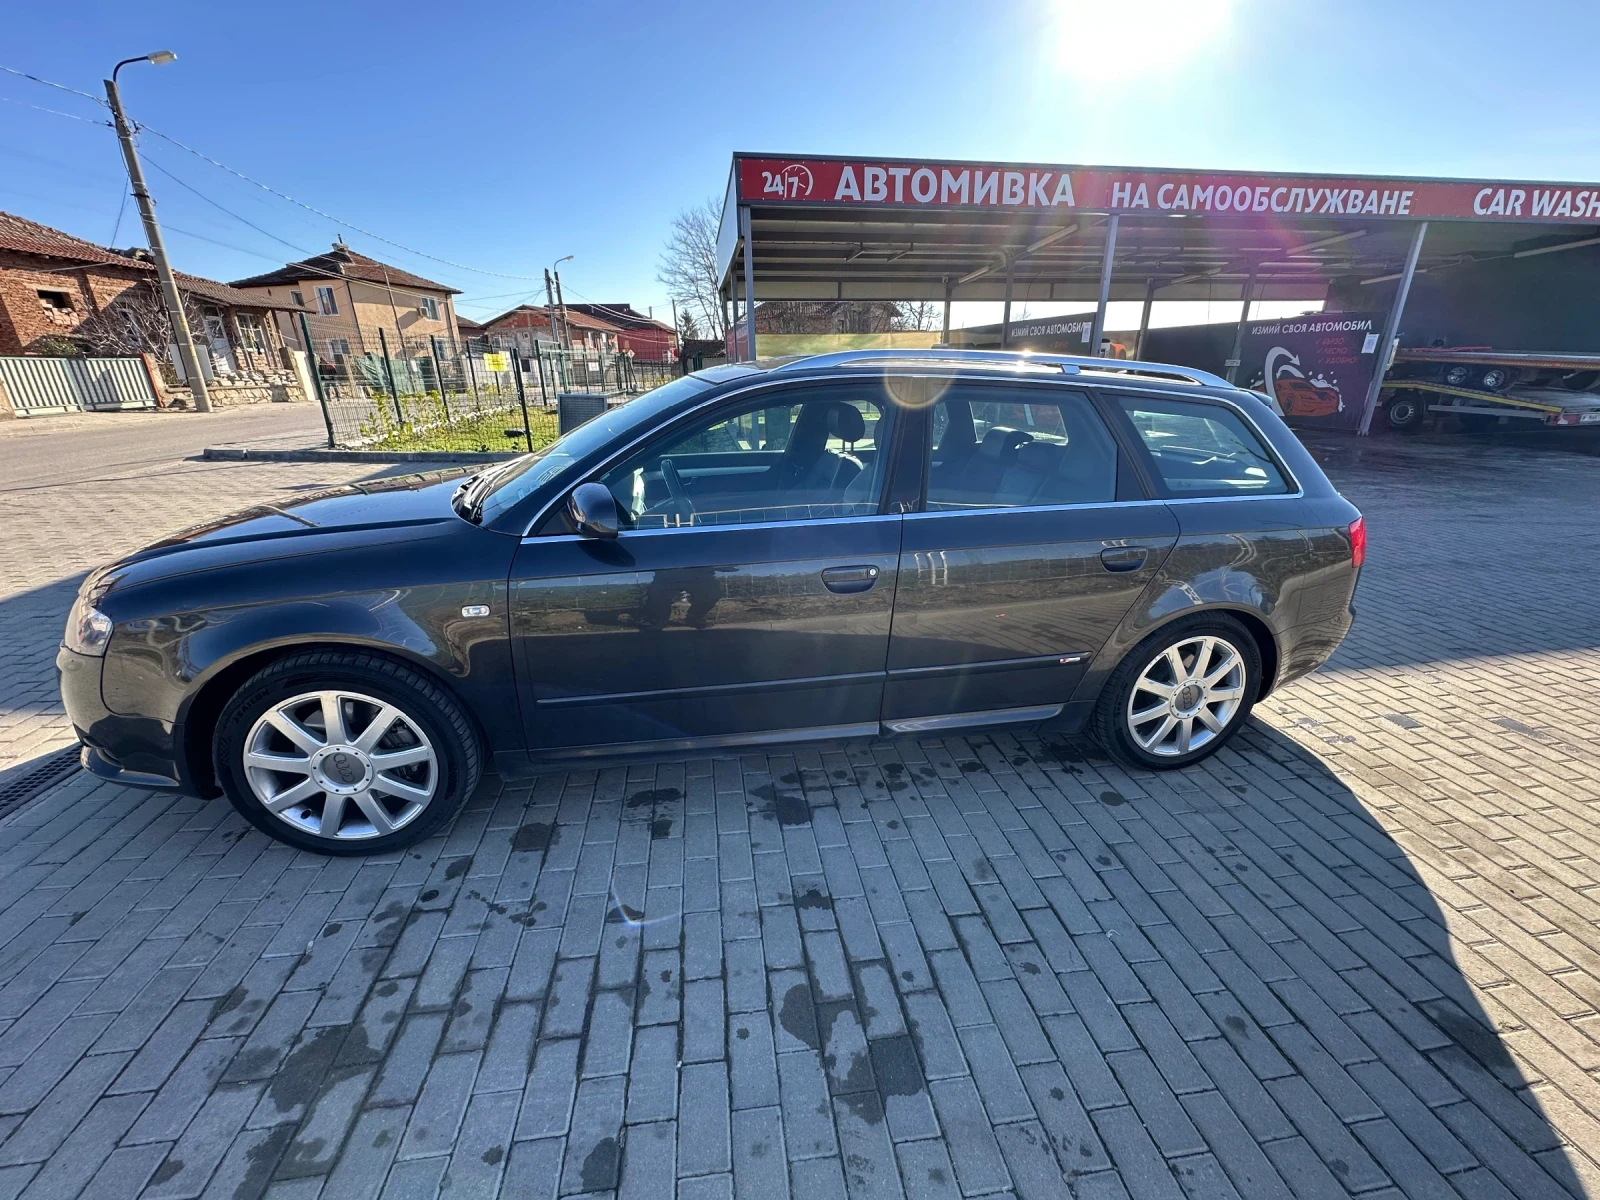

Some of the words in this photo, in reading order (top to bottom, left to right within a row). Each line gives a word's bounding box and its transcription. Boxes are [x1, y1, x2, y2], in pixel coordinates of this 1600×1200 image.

[834, 166, 1076, 207] АВТОМИВКА
[1111, 182, 1149, 208] НА
[1157, 183, 1414, 215] САМООБСЛУЖВАНЕ
[1473, 188, 1526, 216] CAR
[1531, 190, 1600, 217] WASH
[1030, 326, 1045, 336] СВОЯ
[1252, 324, 1280, 335] ИЗМИЙ
[1281, 323, 1307, 334] СВОЯ
[1308, 320, 1372, 332] АВТОМОБИЛ
